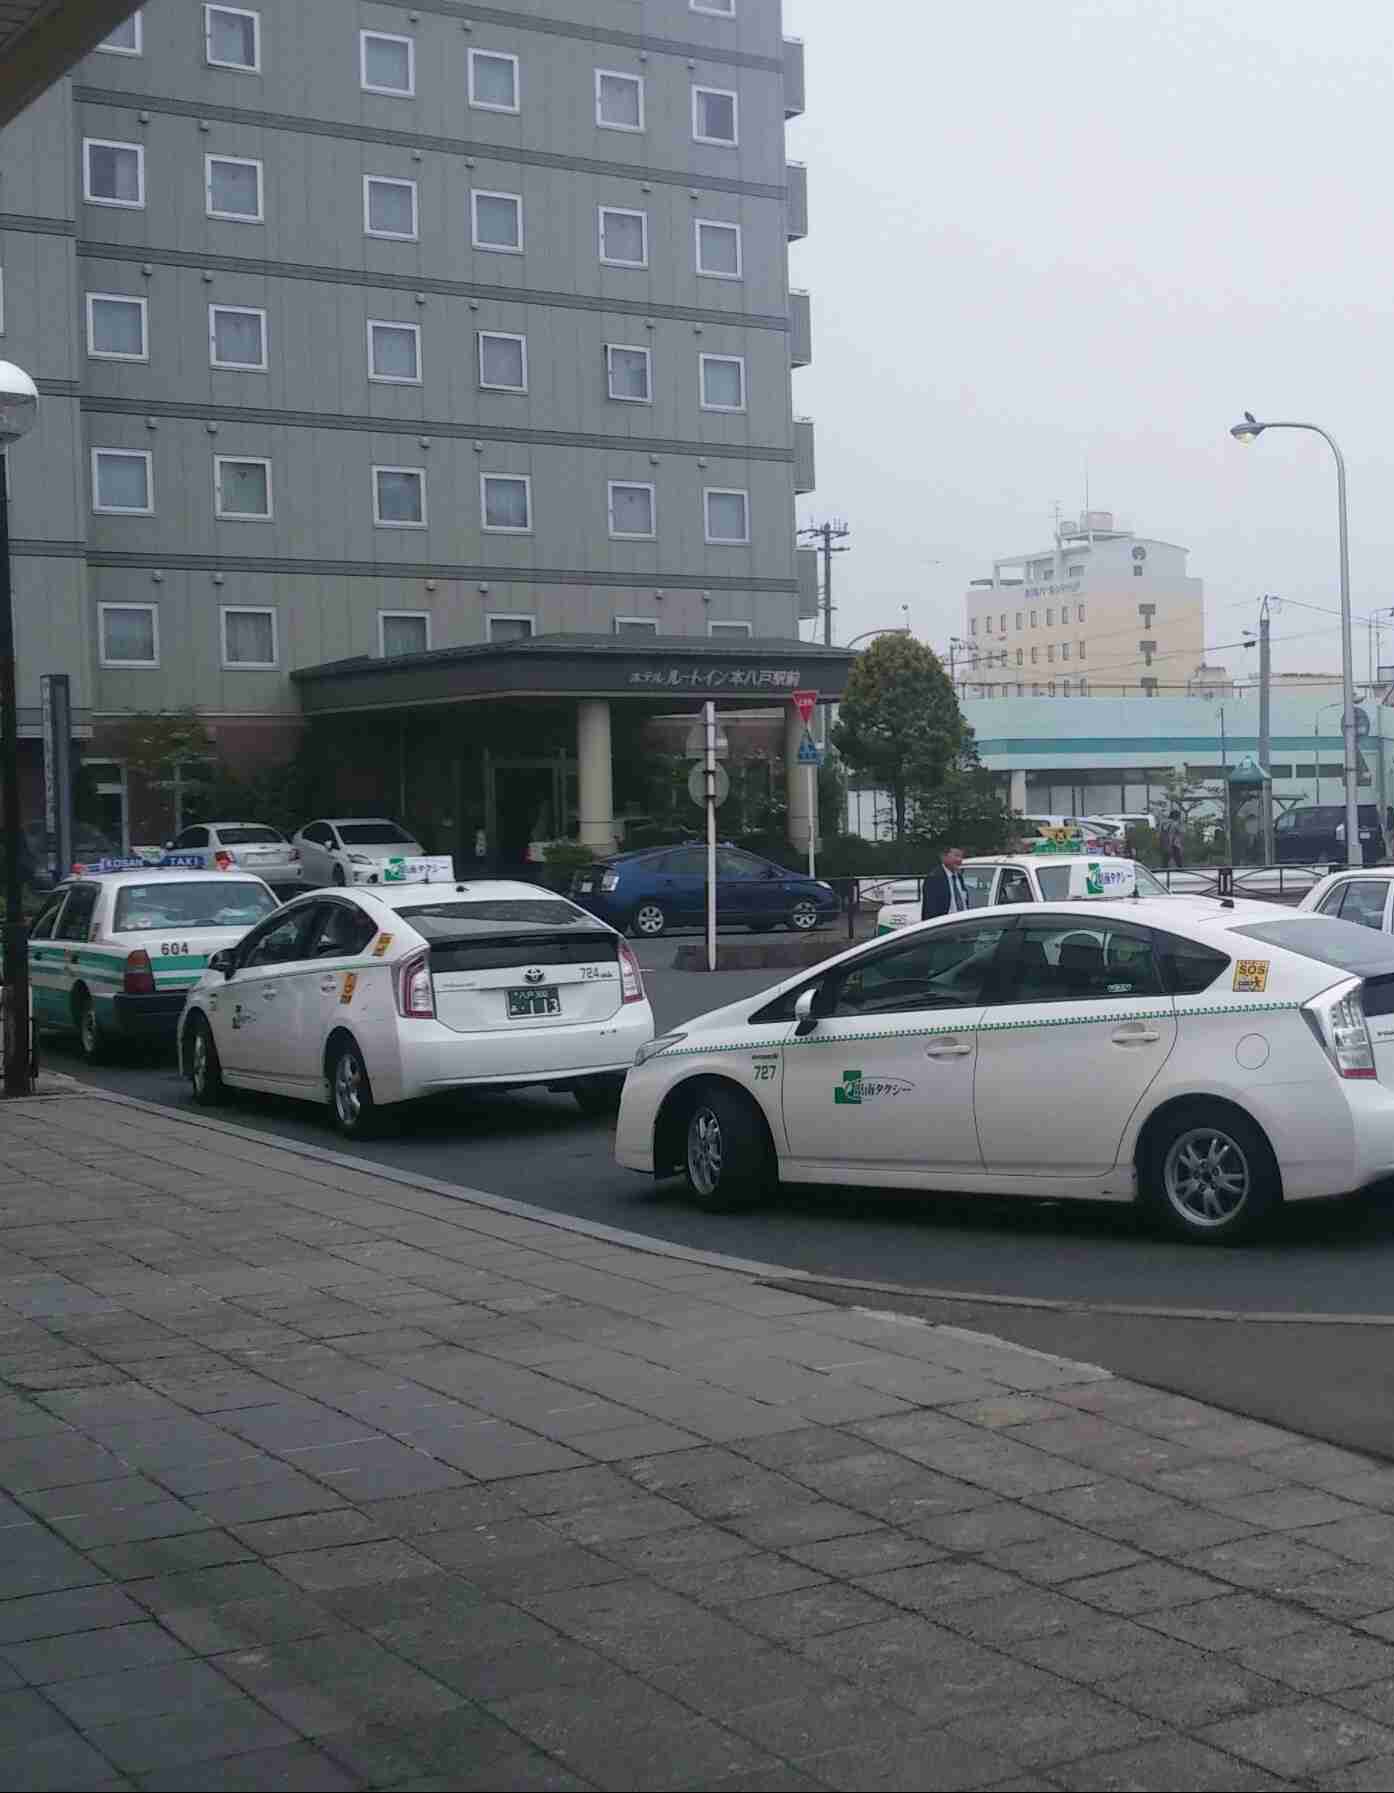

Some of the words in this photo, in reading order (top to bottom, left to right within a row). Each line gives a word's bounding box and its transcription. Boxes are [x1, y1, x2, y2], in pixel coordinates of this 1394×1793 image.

[170, 856, 198, 866] TAXI
[161, 942, 189, 955] 604
[1239, 965, 1265, 975] SOS
[753, 1065, 776, 1080] 727
